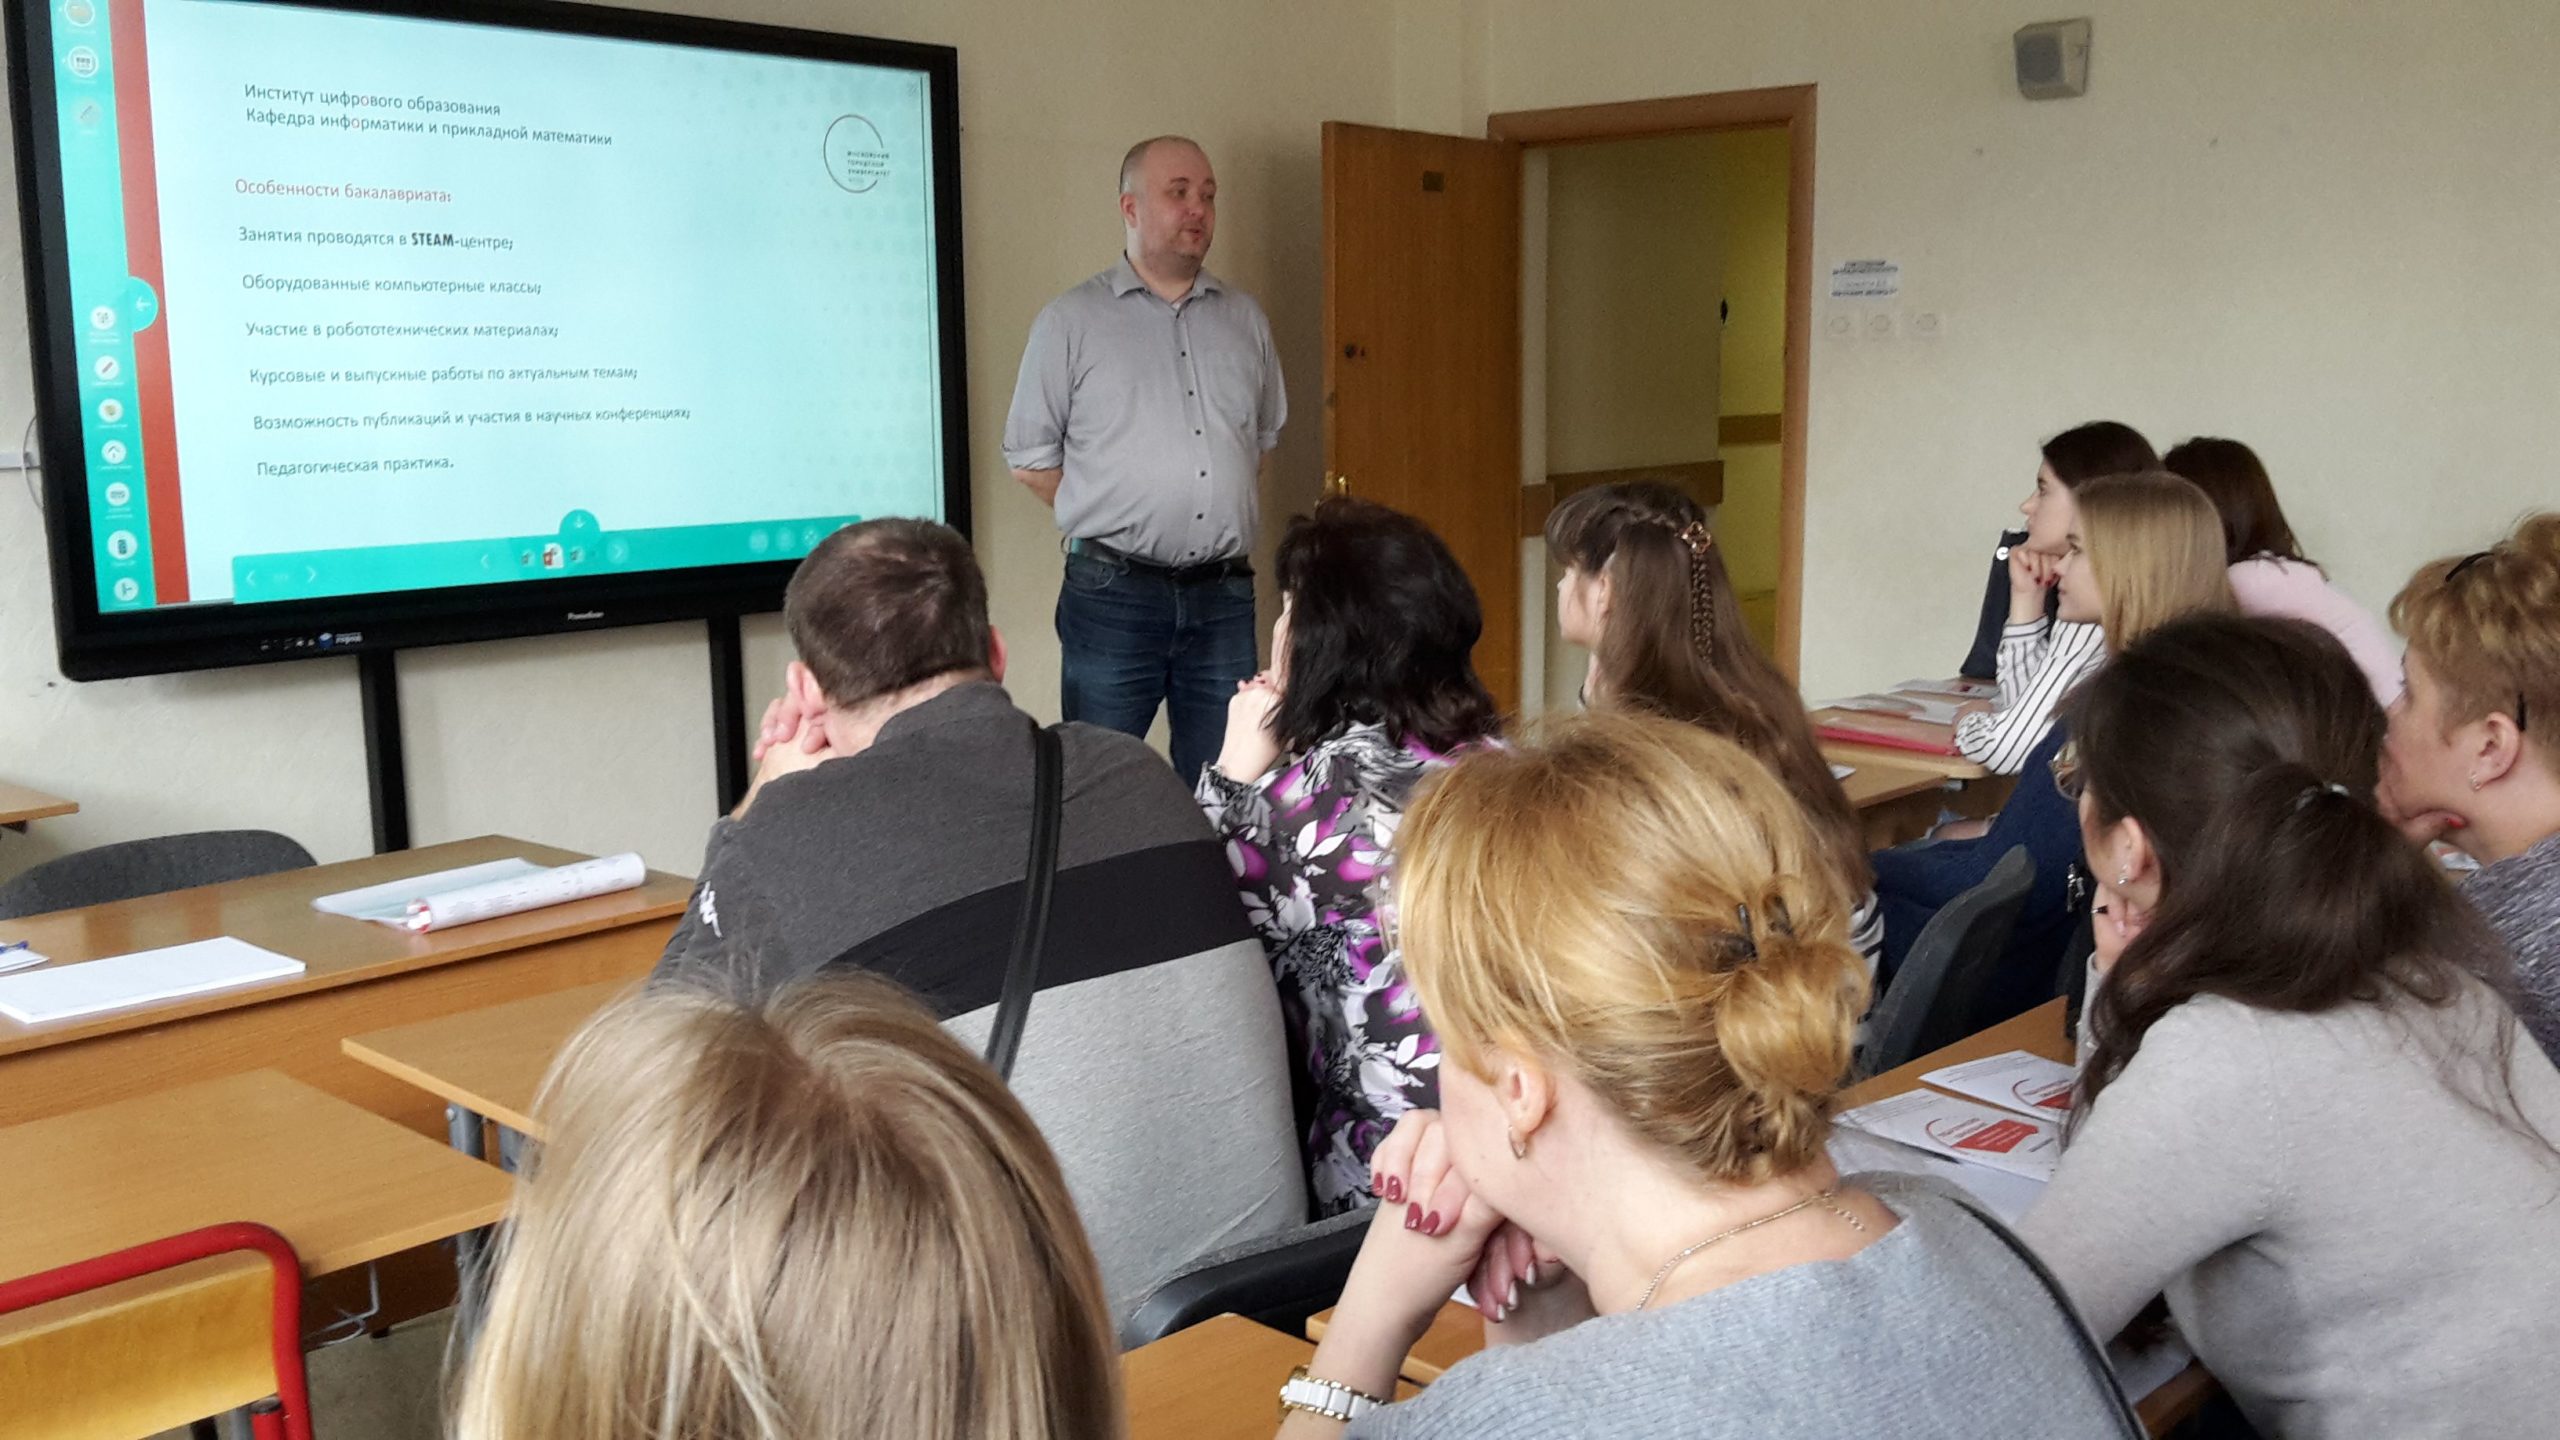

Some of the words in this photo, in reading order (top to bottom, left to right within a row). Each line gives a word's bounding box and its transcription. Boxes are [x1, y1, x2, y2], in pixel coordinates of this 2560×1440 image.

[244, 83, 315, 106] Институт
[319, 90, 403, 112] цифрового
[406, 95, 501, 117] образования
[245, 107, 316, 129] Кафедра
[319, 113, 425, 134] информатики
[428, 122, 438, 135] и
[441, 123, 529, 142] прикладной
[531, 129, 613, 147] математики
[234, 177, 340, 199] Особенности
[344, 182, 453, 205] бакалавриата:
[237, 225, 303, 244] Занятия
[306, 230, 395, 248] проводятся
[398, 234, 408, 247] в
[410, 231, 514, 252] STEAM-центре;
[241, 273, 371, 294] Оборудованные
[374, 279, 486, 296] компьютерные
[489, 281, 542, 296] классы;
[245, 321, 309, 338] Участие
[312, 323, 322, 337] в
[325, 320, 470, 340] робототехнических
[473, 324, 559, 340] материалах;
[249, 367, 327, 387] Курсовые
[330, 370, 341, 383] и
[344, 369, 428, 385] выпускные
[430, 365, 485, 384] работы
[487, 368, 505, 381] по
[507, 367, 590, 383] актуальным
[592, 366, 639, 381] темам;
[252, 414, 359, 432] Возможность
[362, 410, 452, 430] публикаций
[454, 414, 465, 426] и
[467, 411, 521, 428] участия
[524, 410, 534, 423] в
[535, 410, 593, 425] научных
[594, 406, 692, 424] конференциях;
[256, 460, 379, 478] Педагогическая
[382, 457, 456, 475] практика.
